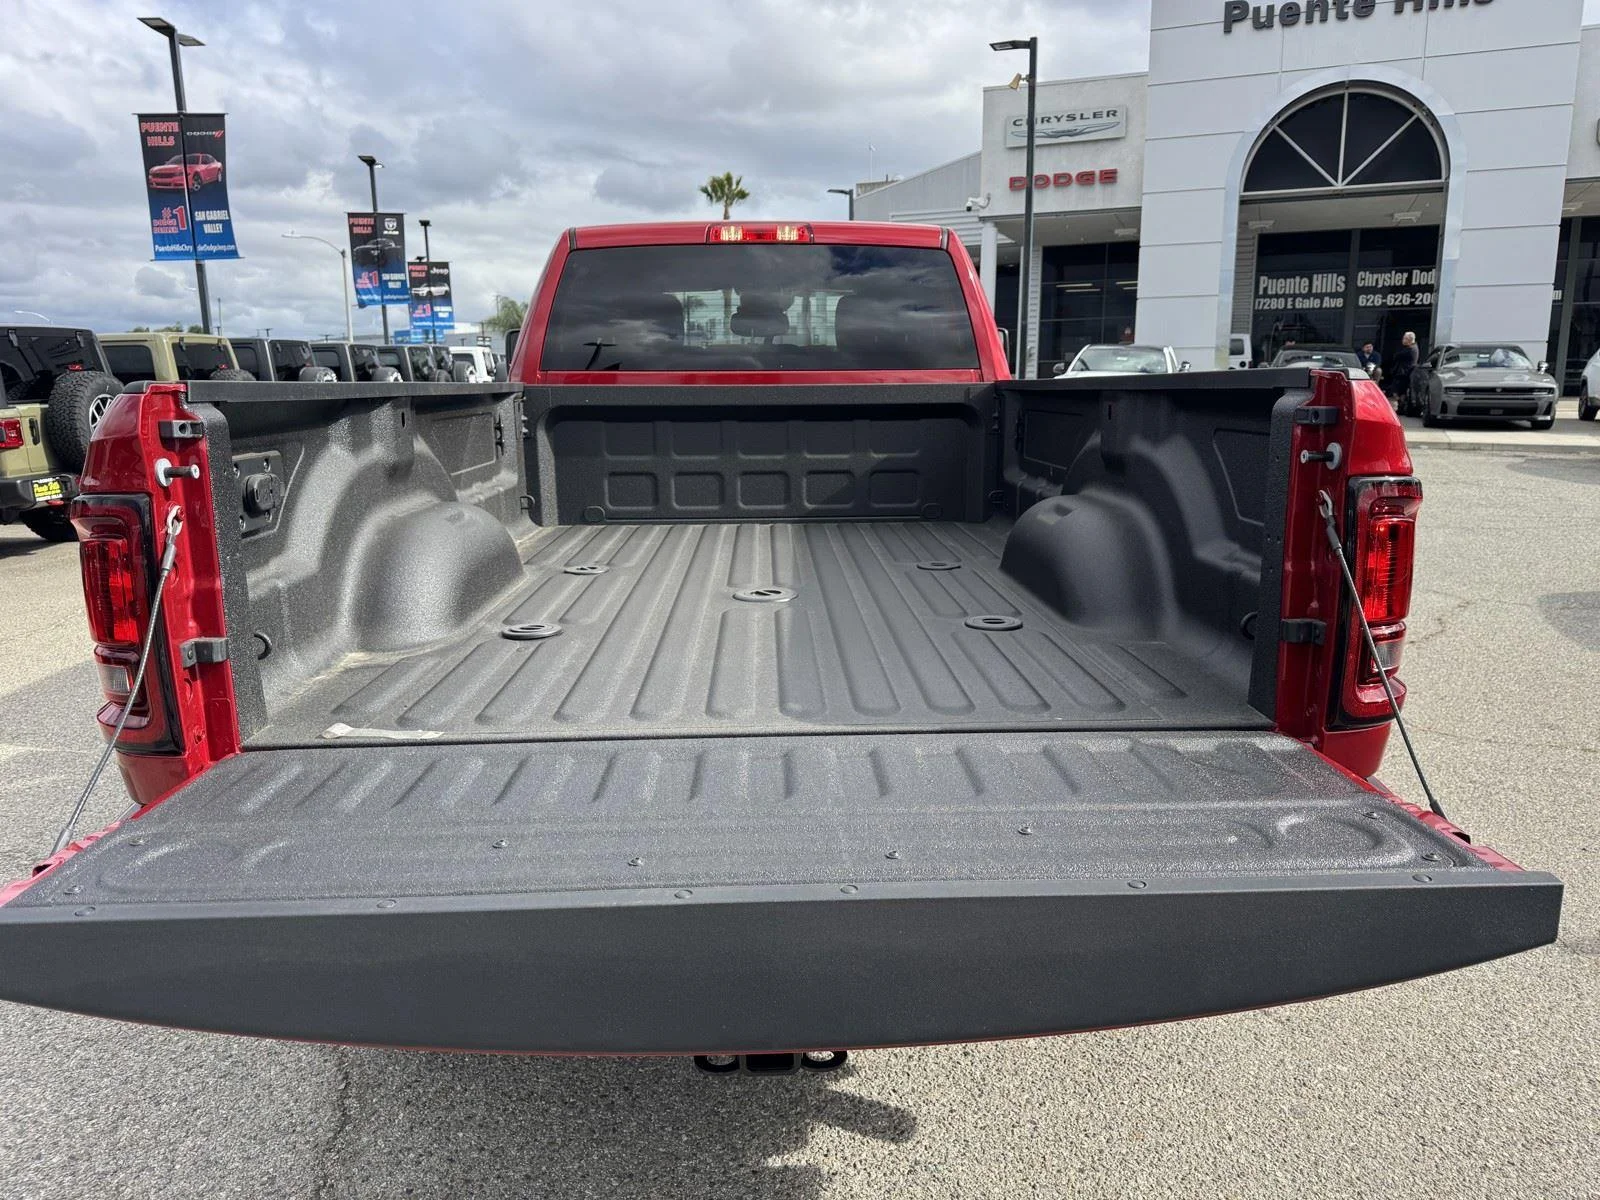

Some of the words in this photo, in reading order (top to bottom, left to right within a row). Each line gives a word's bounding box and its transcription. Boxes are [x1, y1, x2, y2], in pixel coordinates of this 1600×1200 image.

[1223, 0, 1376, 34] Puente
[140, 122, 179, 132] PUENTE
[147, 136, 175, 146] HILLS
[1008, 169, 1118, 191] DODGE
[1258, 275, 1310, 295] Puente
[1311, 273, 1346, 293] Hills
[1356, 270, 1408, 288] Chrysler
[1254, 298, 1285, 310] 17280
[1286, 297, 1294, 309] E
[1295, 296, 1321, 309] Gale
[1322, 296, 1344, 308] Ave
